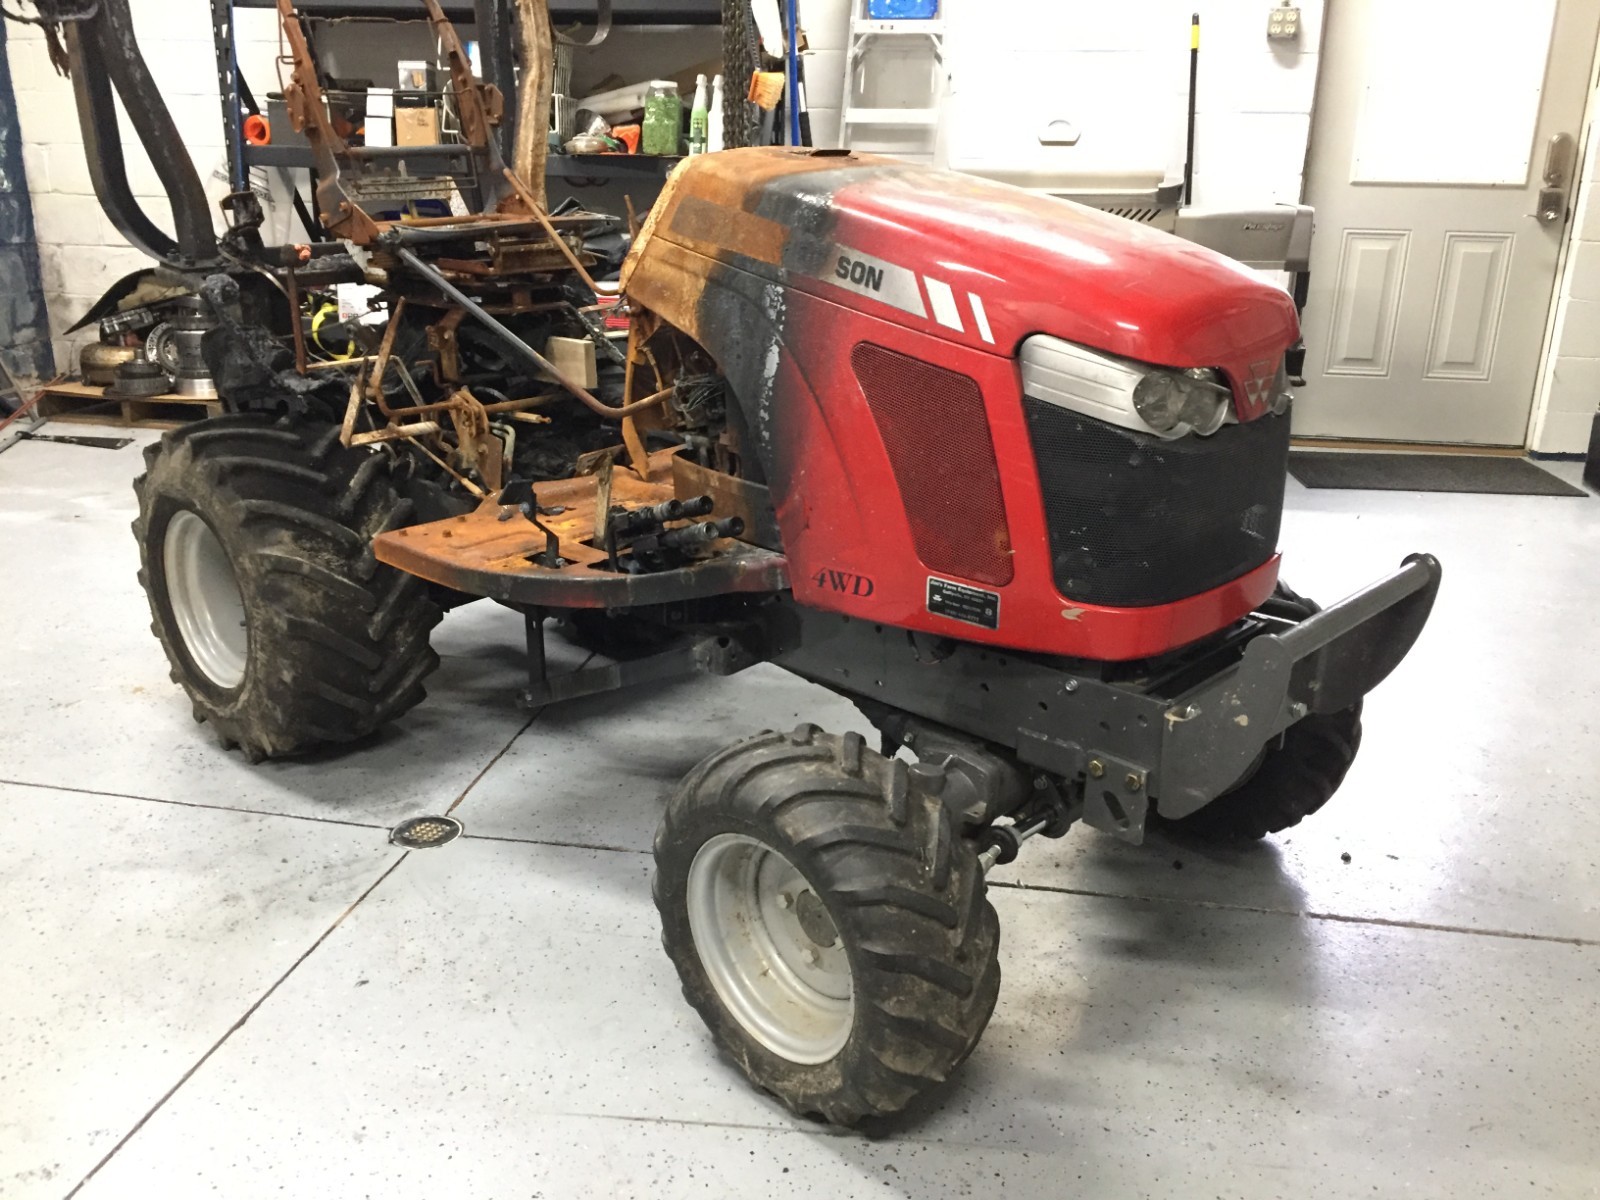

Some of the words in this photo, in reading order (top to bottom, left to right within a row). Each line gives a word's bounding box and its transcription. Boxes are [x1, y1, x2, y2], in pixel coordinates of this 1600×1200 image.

[835, 255, 884, 291] SON
[812, 567, 874, 597] 4WD
[943, 583, 957, 591] Farm
